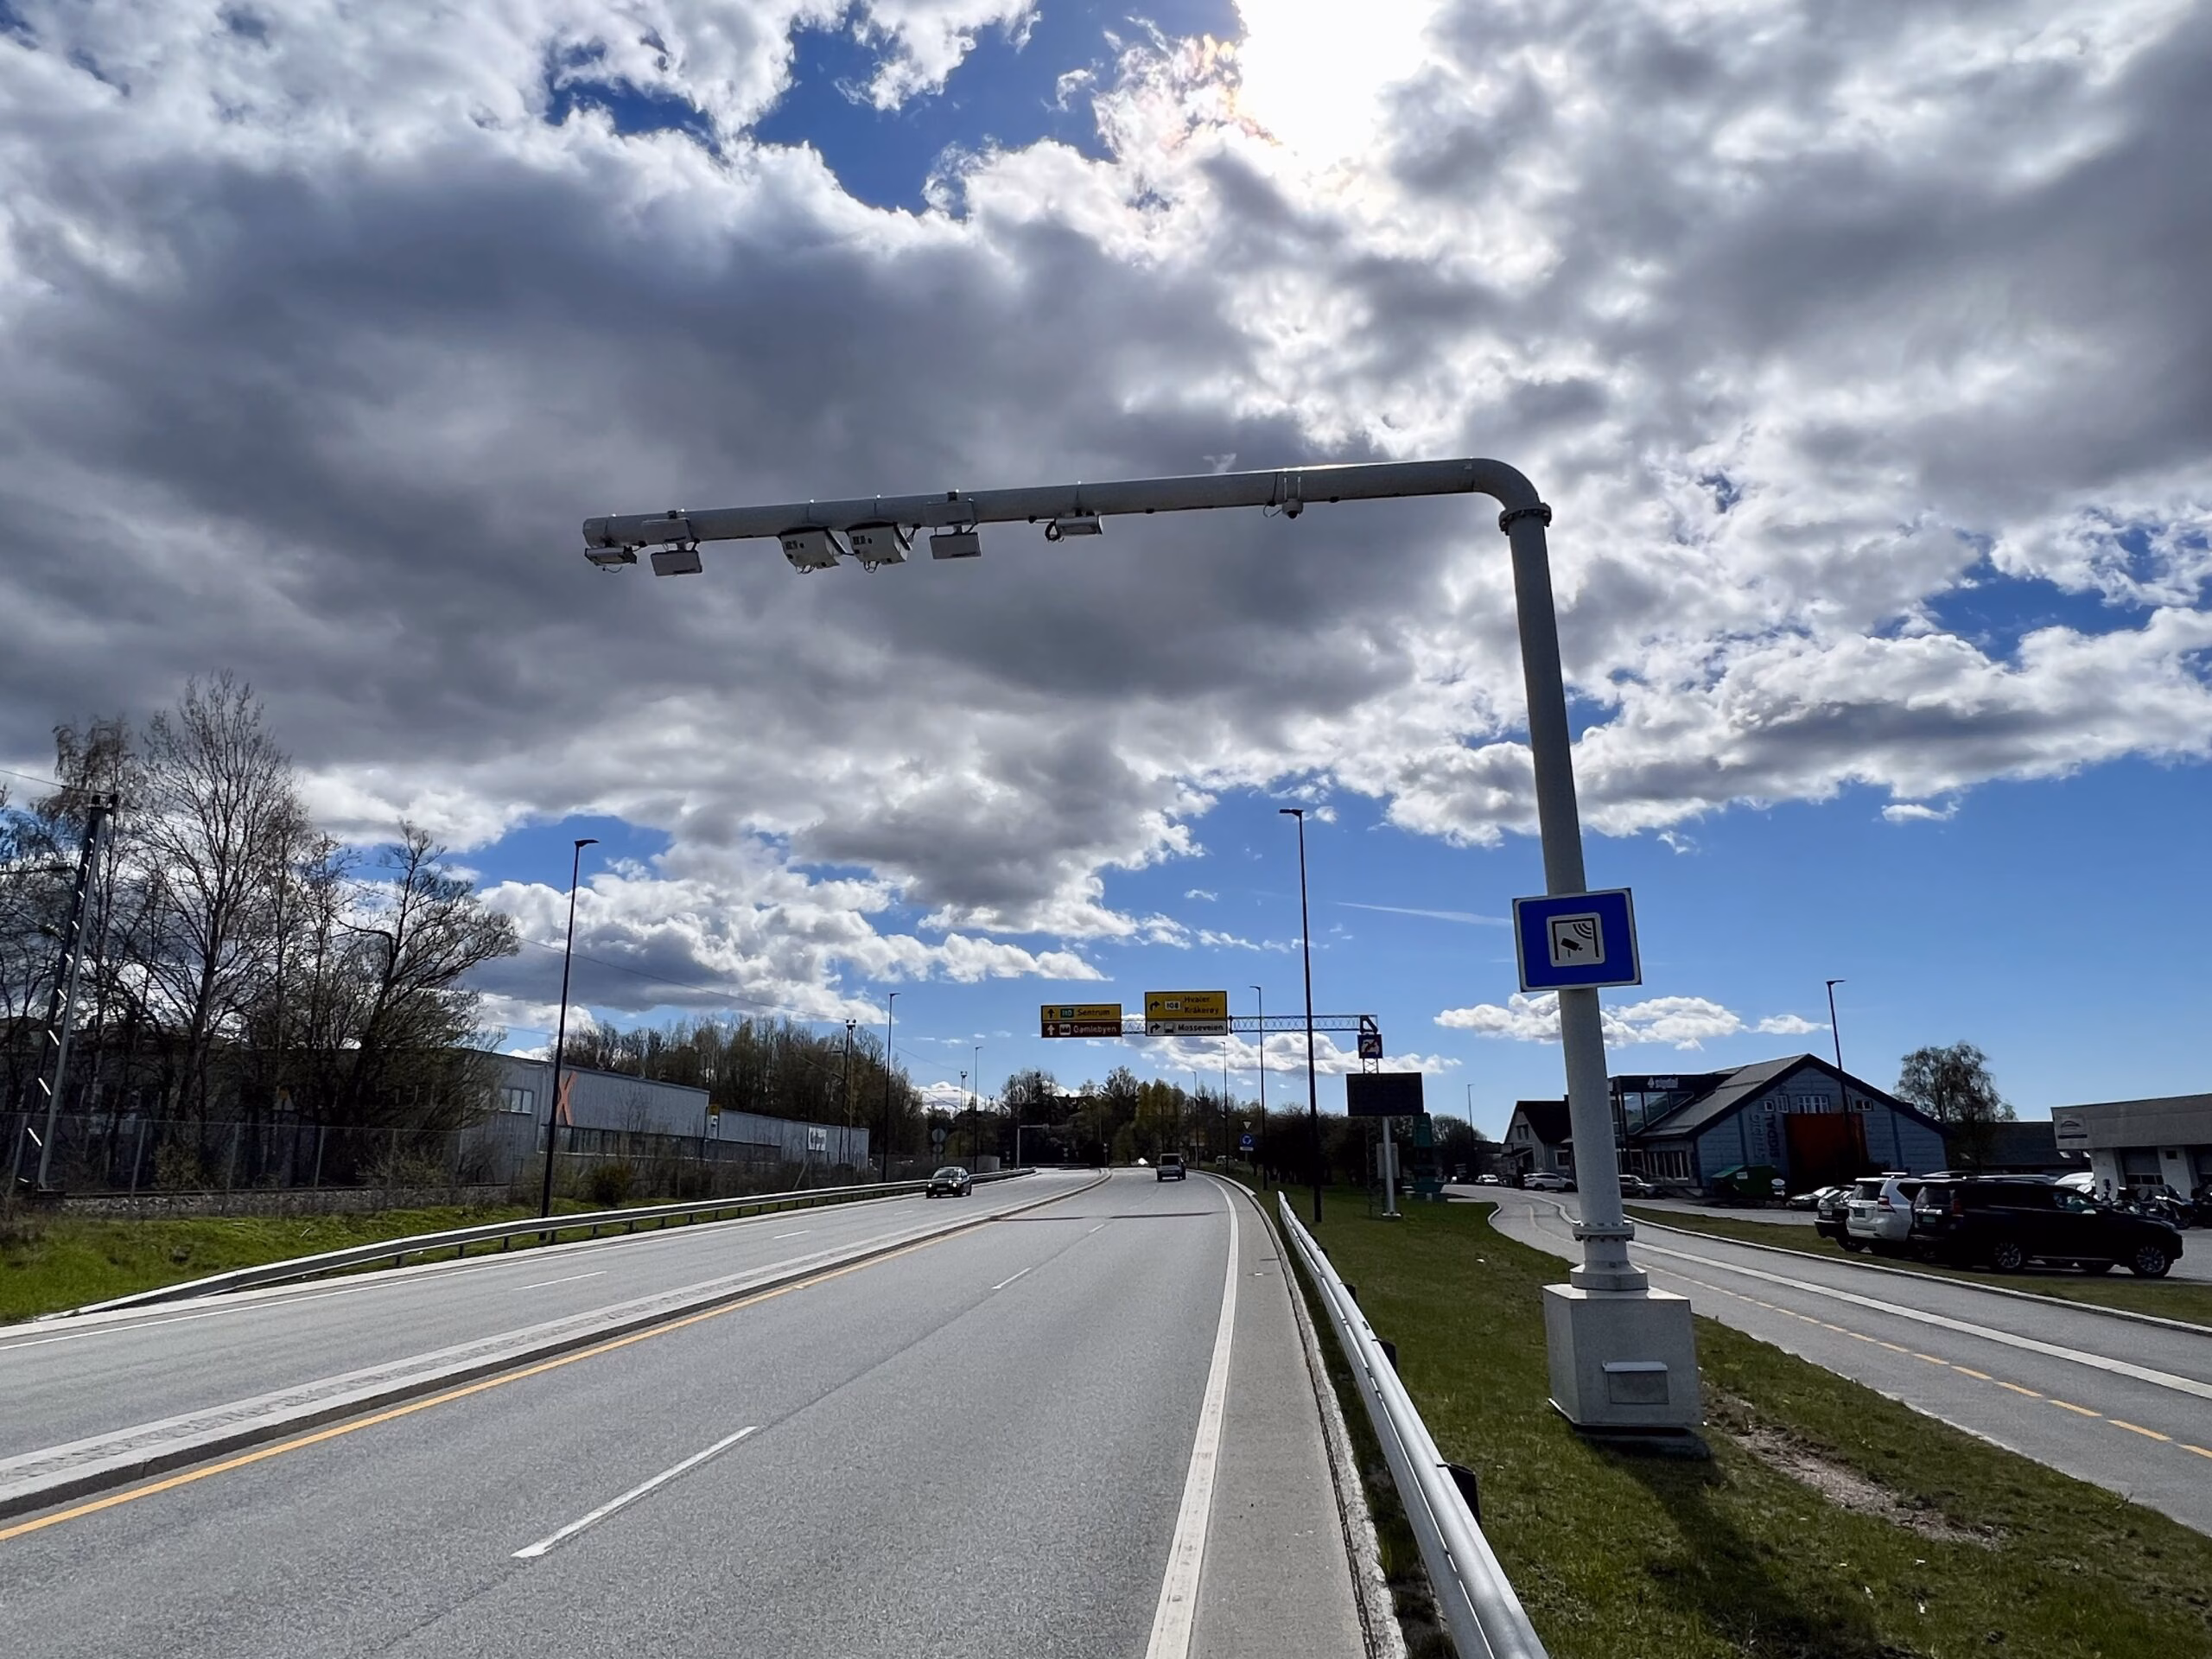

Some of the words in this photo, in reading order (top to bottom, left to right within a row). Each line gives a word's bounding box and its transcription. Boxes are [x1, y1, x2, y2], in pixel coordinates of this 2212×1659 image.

[1184, 1006, 1219, 1014] Kråkerøy
[1073, 1025, 1117, 1034] Gamlebyen
[1765, 1114, 1780, 1159] SIGDAL
